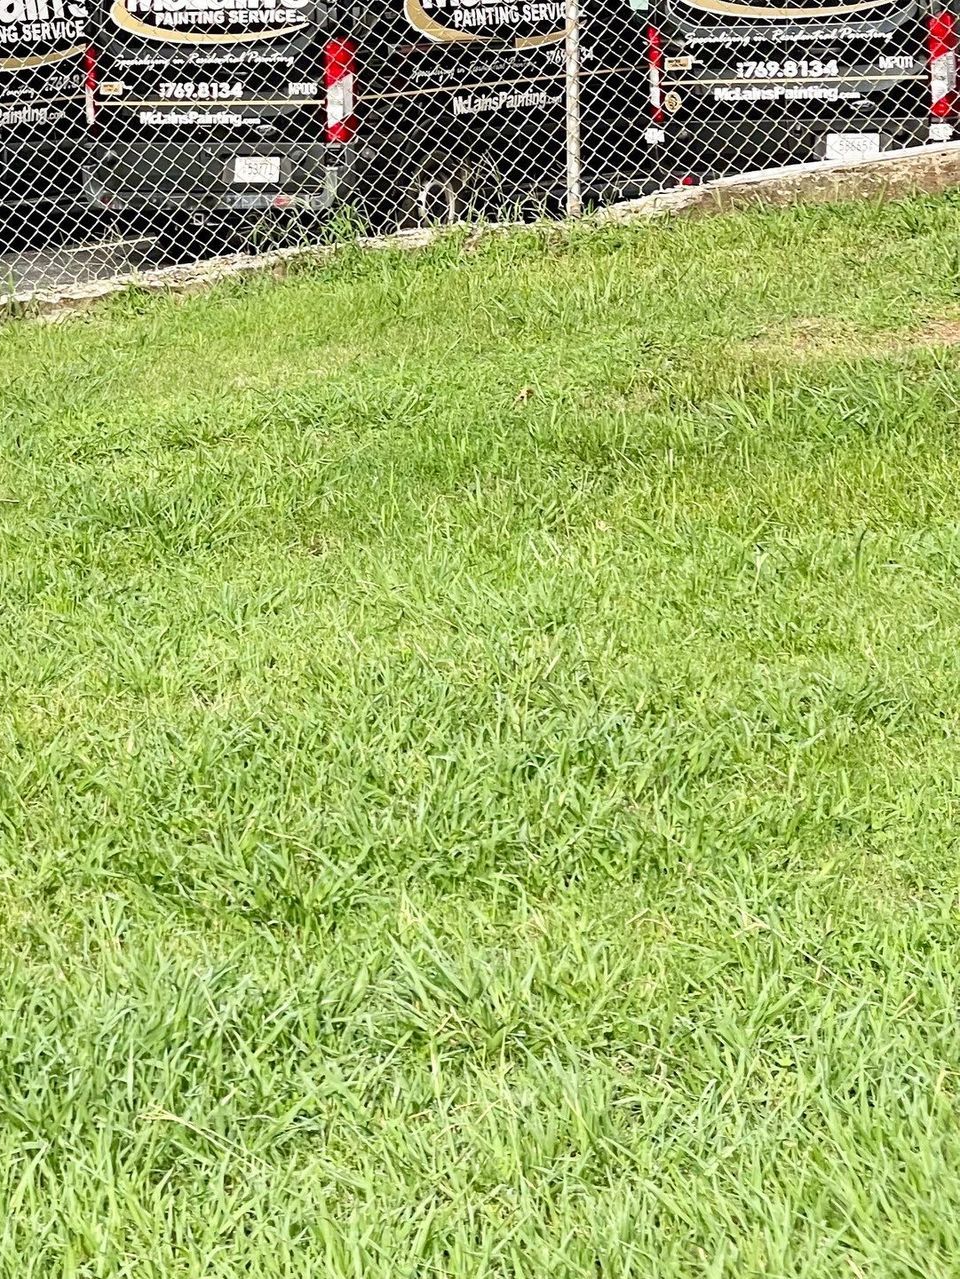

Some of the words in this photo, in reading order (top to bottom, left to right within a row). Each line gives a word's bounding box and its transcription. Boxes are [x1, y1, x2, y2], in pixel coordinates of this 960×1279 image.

[156, 11, 225, 26] PAINTING
[228, 10, 297, 24] SERVICE
[454, 4, 520, 28] PAINTING
[522, 1, 568, 21] SERVIC
[22, 20, 85, 42] SERVICE
[453, 89, 563, 115] McLainsPainting.com
